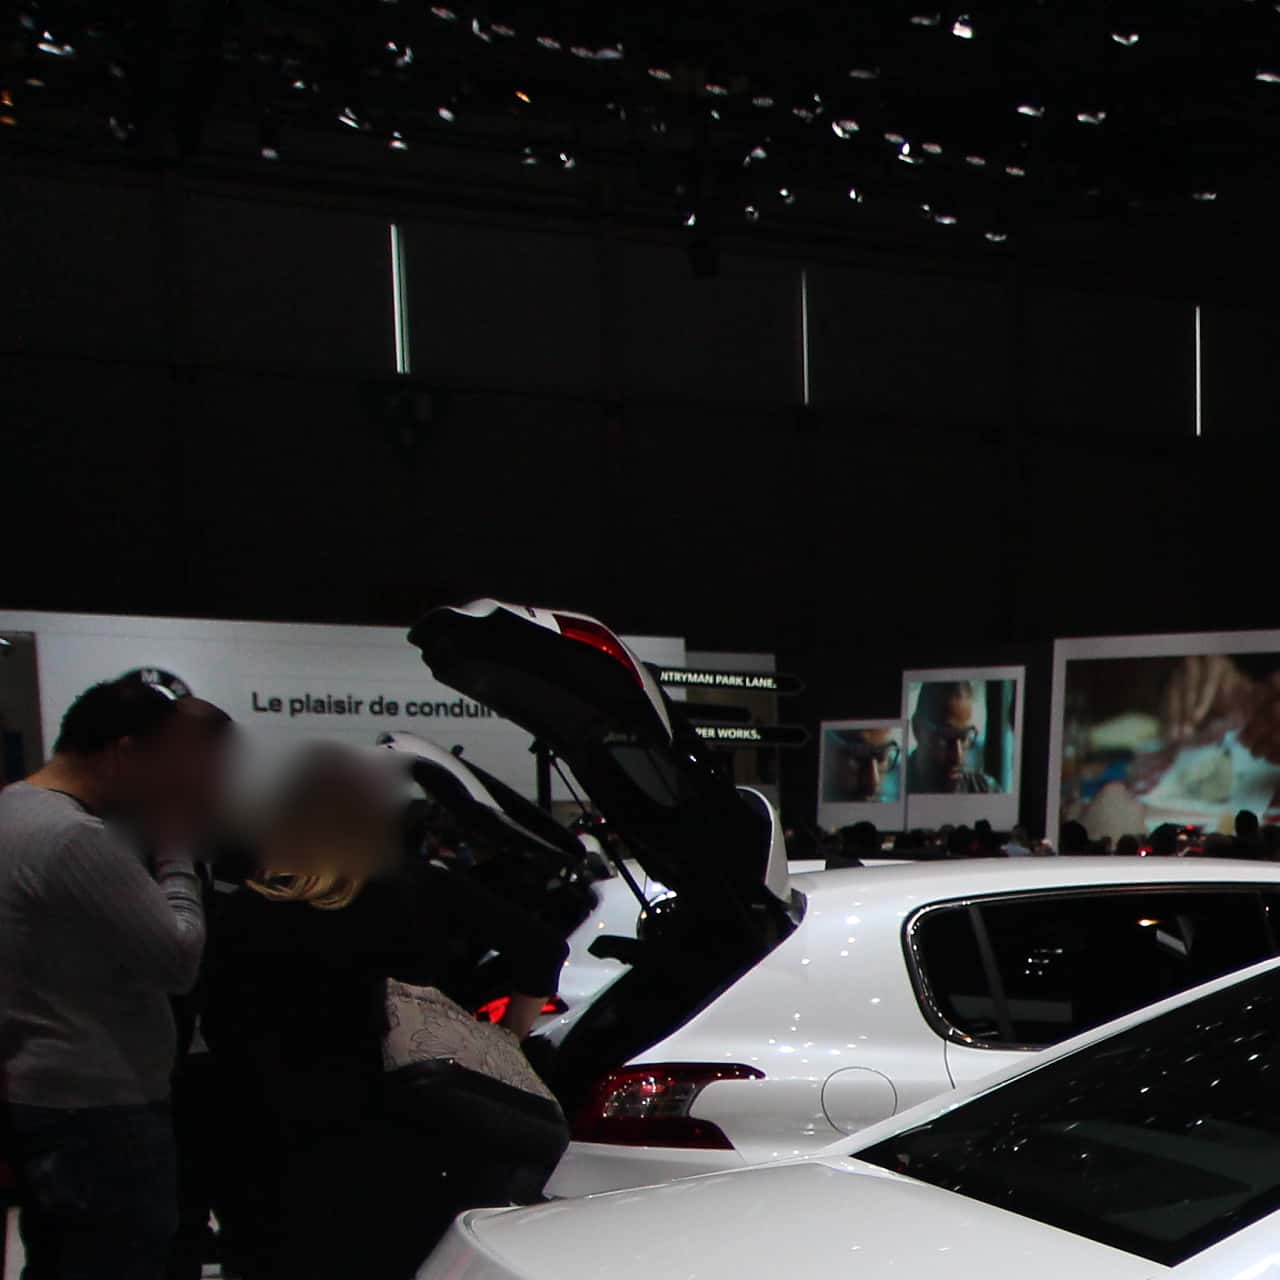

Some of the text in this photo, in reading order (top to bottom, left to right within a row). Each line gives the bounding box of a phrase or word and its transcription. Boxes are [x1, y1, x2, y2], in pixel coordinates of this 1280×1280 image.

[716, 675, 744, 687] PARK
[746, 677, 777, 689] LANE.
[252, 692, 282, 712] Le
[289, 694, 364, 717] plaisir
[369, 696, 400, 716] de
[717, 728, 761, 740] WORKS.
